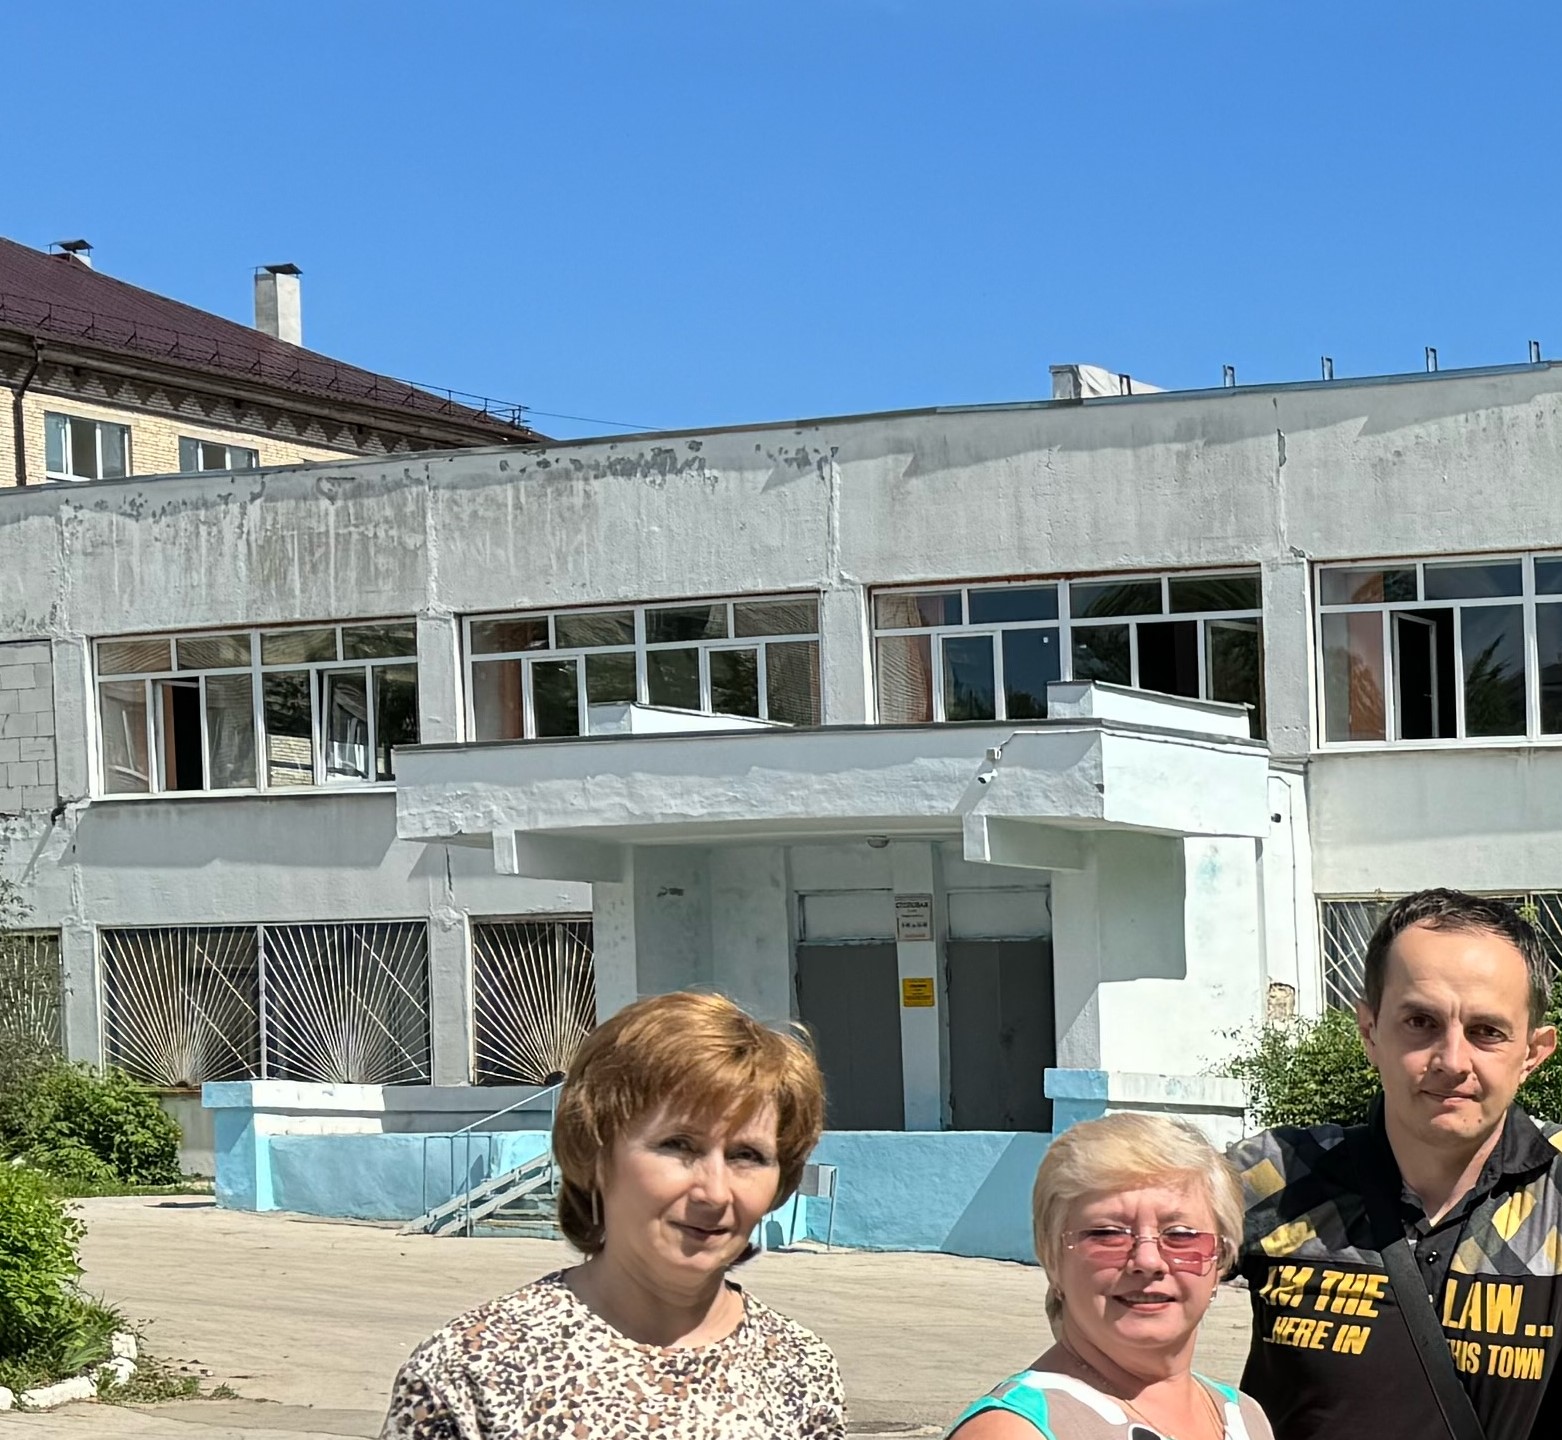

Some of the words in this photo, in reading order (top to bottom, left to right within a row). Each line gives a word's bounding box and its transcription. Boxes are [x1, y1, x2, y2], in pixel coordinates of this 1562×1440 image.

[1314, 1269, 1389, 1318] THE
[1332, 1324, 1371, 1355] IN
[1446, 1339, 1481, 1374] HIS
[1488, 1344, 1545, 1380] TOWN
